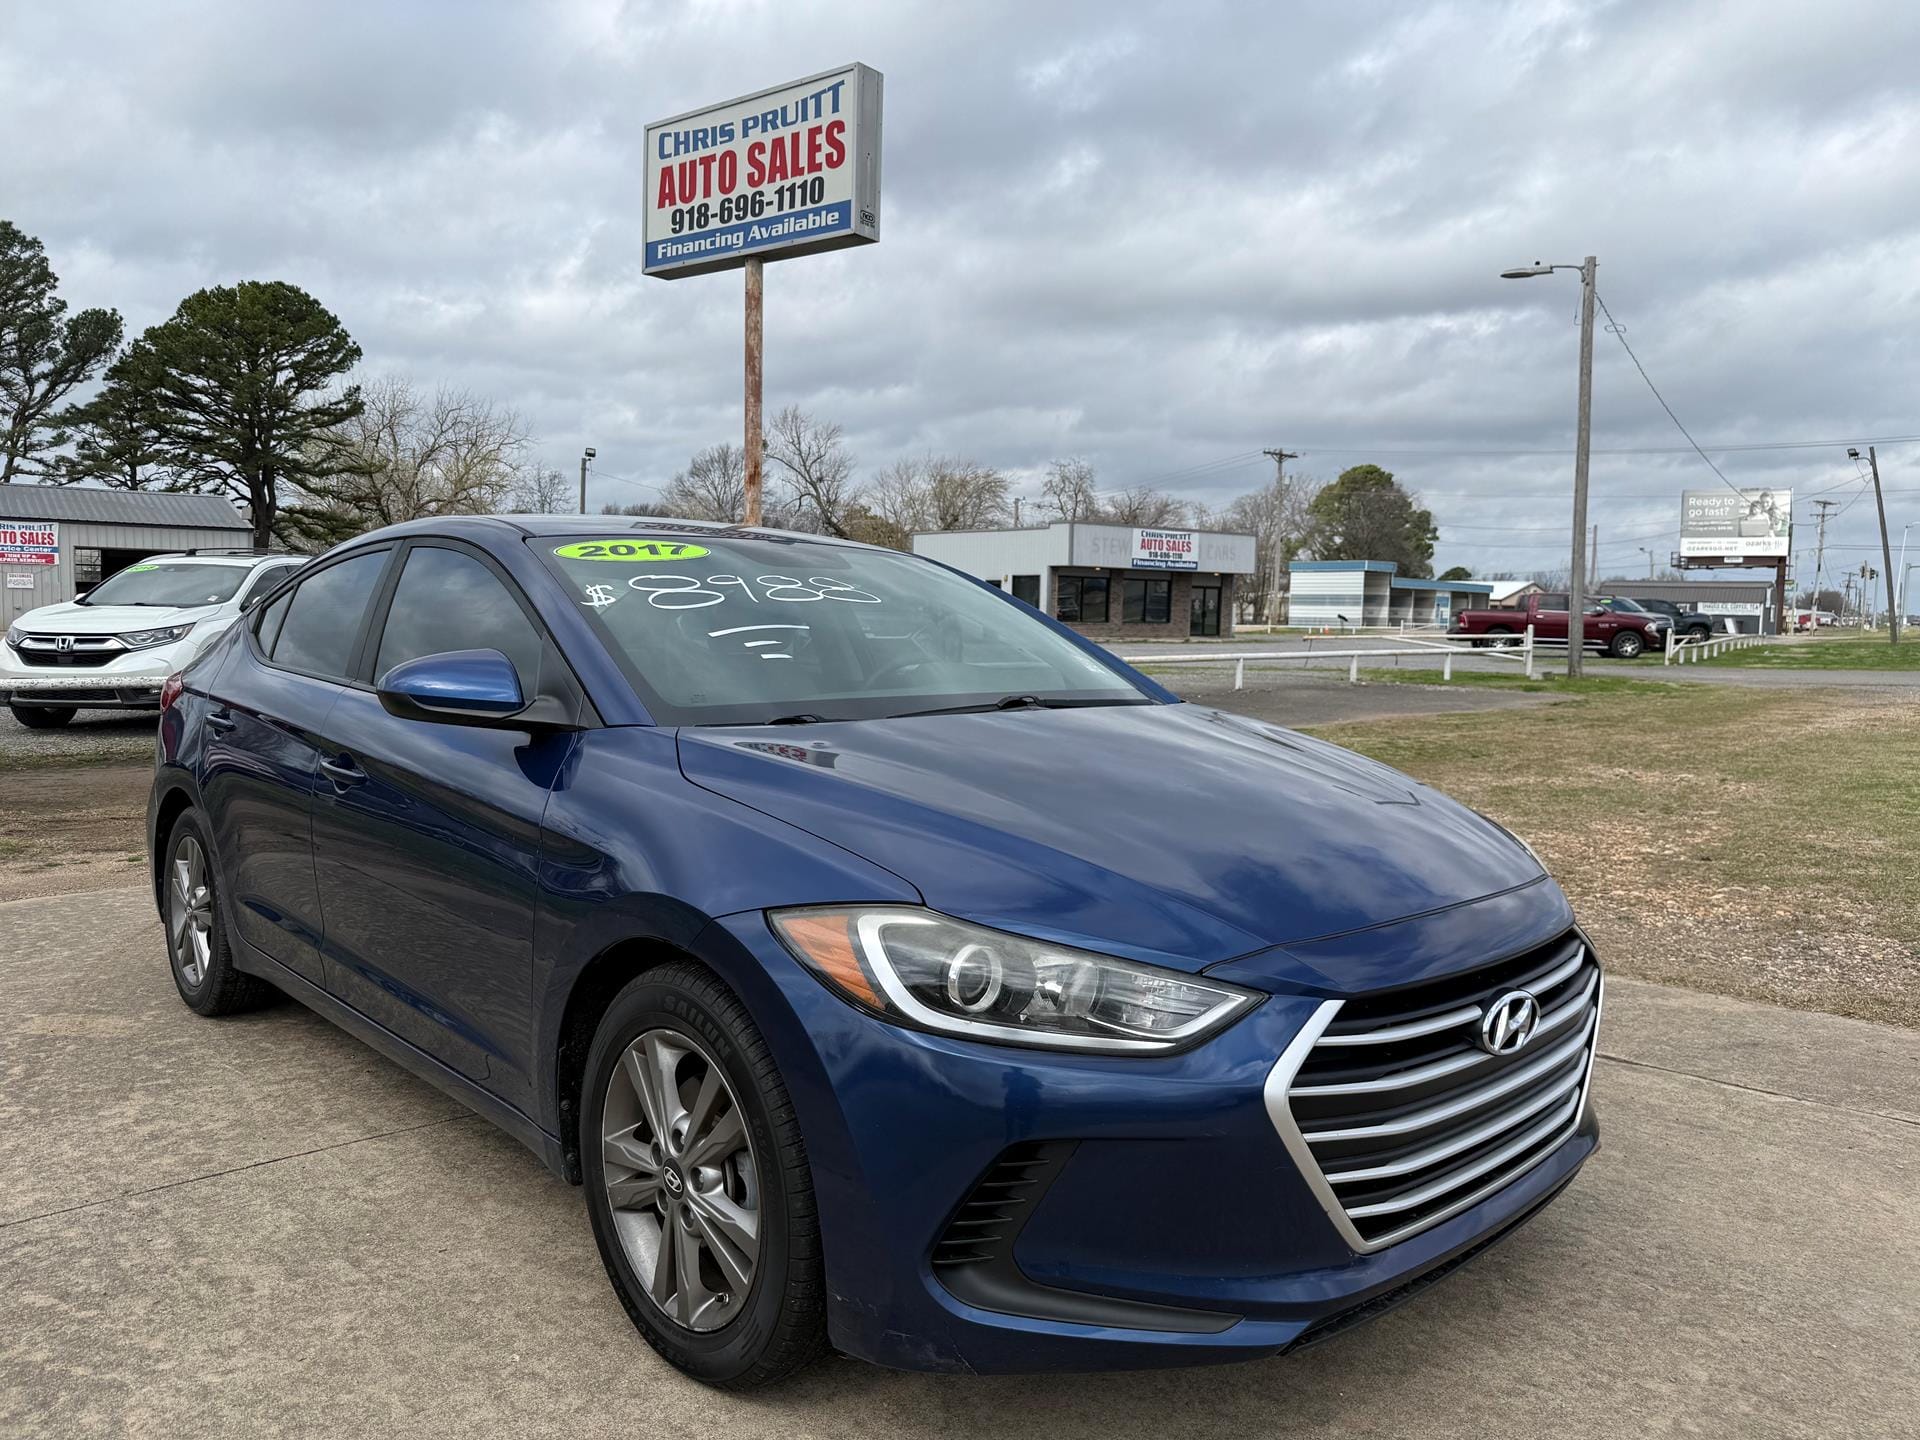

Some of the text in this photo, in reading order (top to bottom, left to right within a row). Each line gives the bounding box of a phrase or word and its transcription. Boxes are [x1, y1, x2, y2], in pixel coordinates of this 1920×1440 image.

[658, 79, 845, 160] CHRIS PRUITT
[657, 119, 846, 209] AUTO SALES
[671, 176, 825, 234] 918-696-1110
[657, 210, 839, 259] Financing Available
[1689, 497, 1735, 507] Ready to
[1688, 507, 1730, 518] go fast?
[18, 523, 55, 531] PRUITT
[1141, 530, 1164, 538] CHRIS
[20, 531, 55, 546] SALES
[1140, 538, 1192, 553] AUTO SALES
[577, 543, 690, 558] 2017
[1132, 559, 1197, 569] Financing Available
[663, 995, 731, 1057] SAILUN
